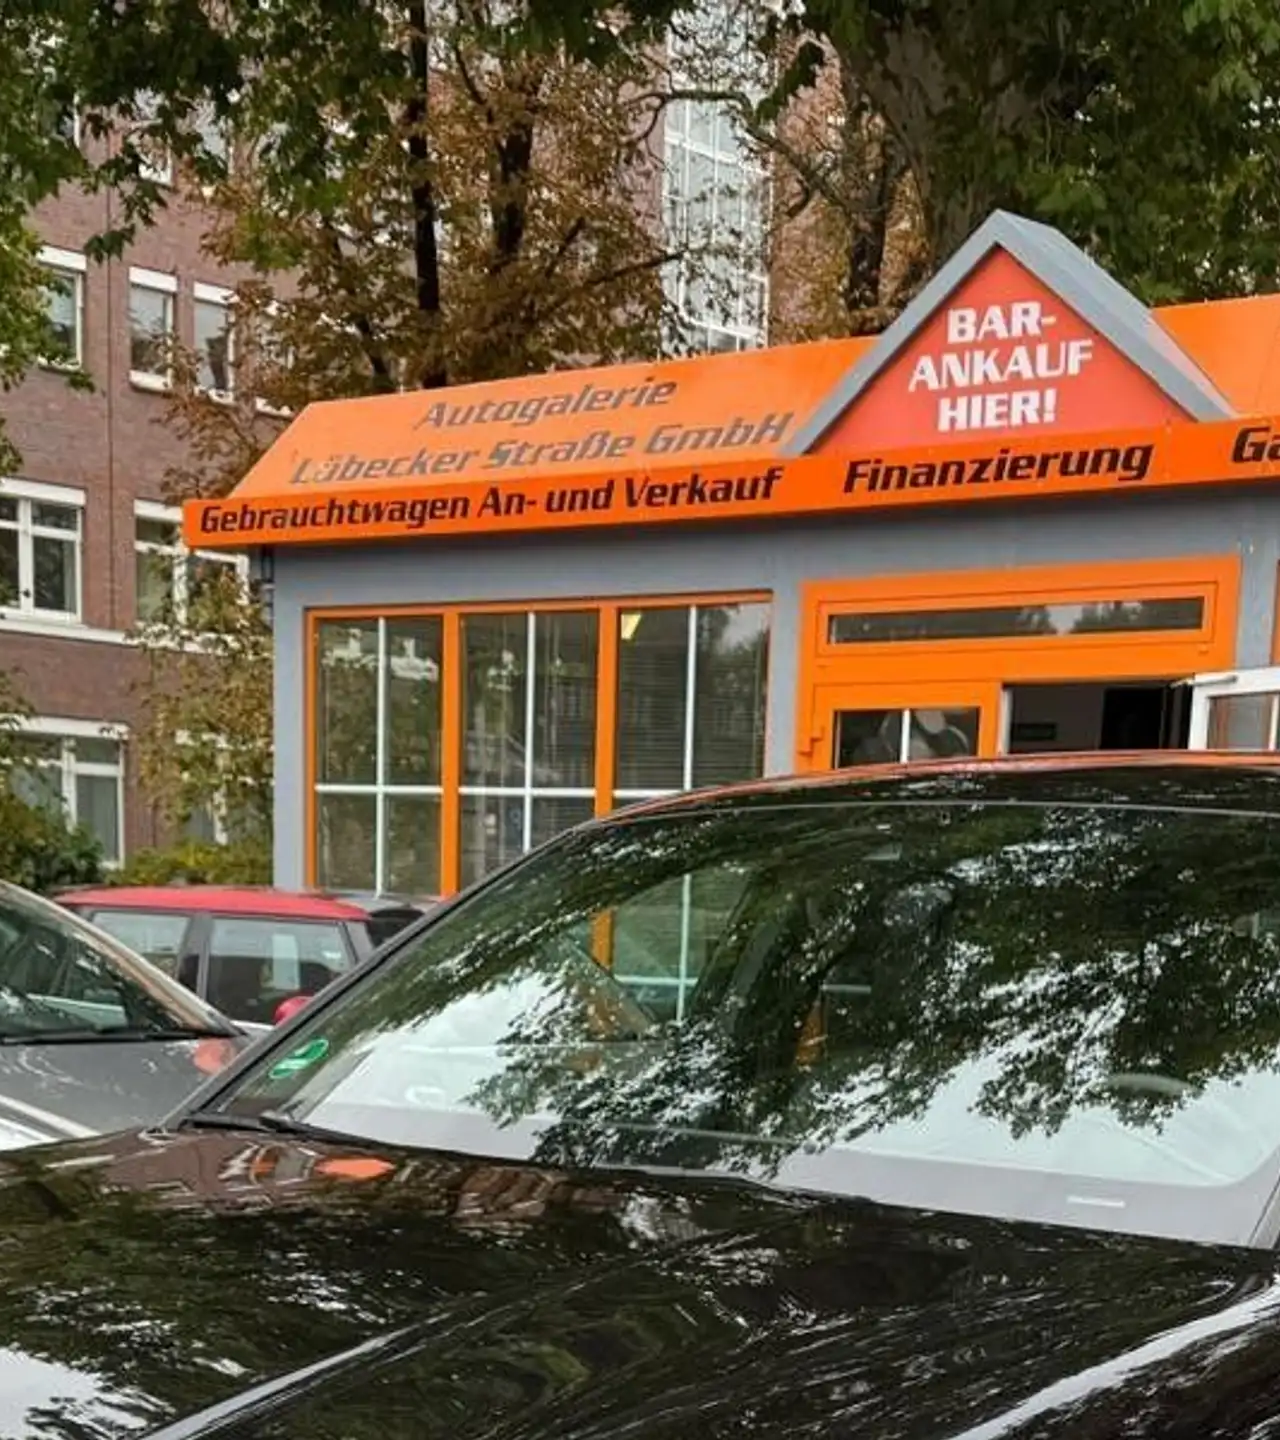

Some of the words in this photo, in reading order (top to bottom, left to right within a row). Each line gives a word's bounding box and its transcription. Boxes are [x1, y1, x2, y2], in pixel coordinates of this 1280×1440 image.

[947, 301, 1057, 343] BAR-
[908, 339, 1094, 392] ANKAUF
[414, 376, 678, 431] Autogalerie
[937, 388, 1057, 432] HIER!
[487, 430, 636, 469] Straße
[645, 412, 796, 455] GmbH
[843, 443, 1155, 494] Finanzierung
[199, 495, 470, 533] Gebrauchtwagen
[477, 486, 537, 517] An-
[544, 479, 615, 514] und
[625, 466, 785, 508] Verkauf
